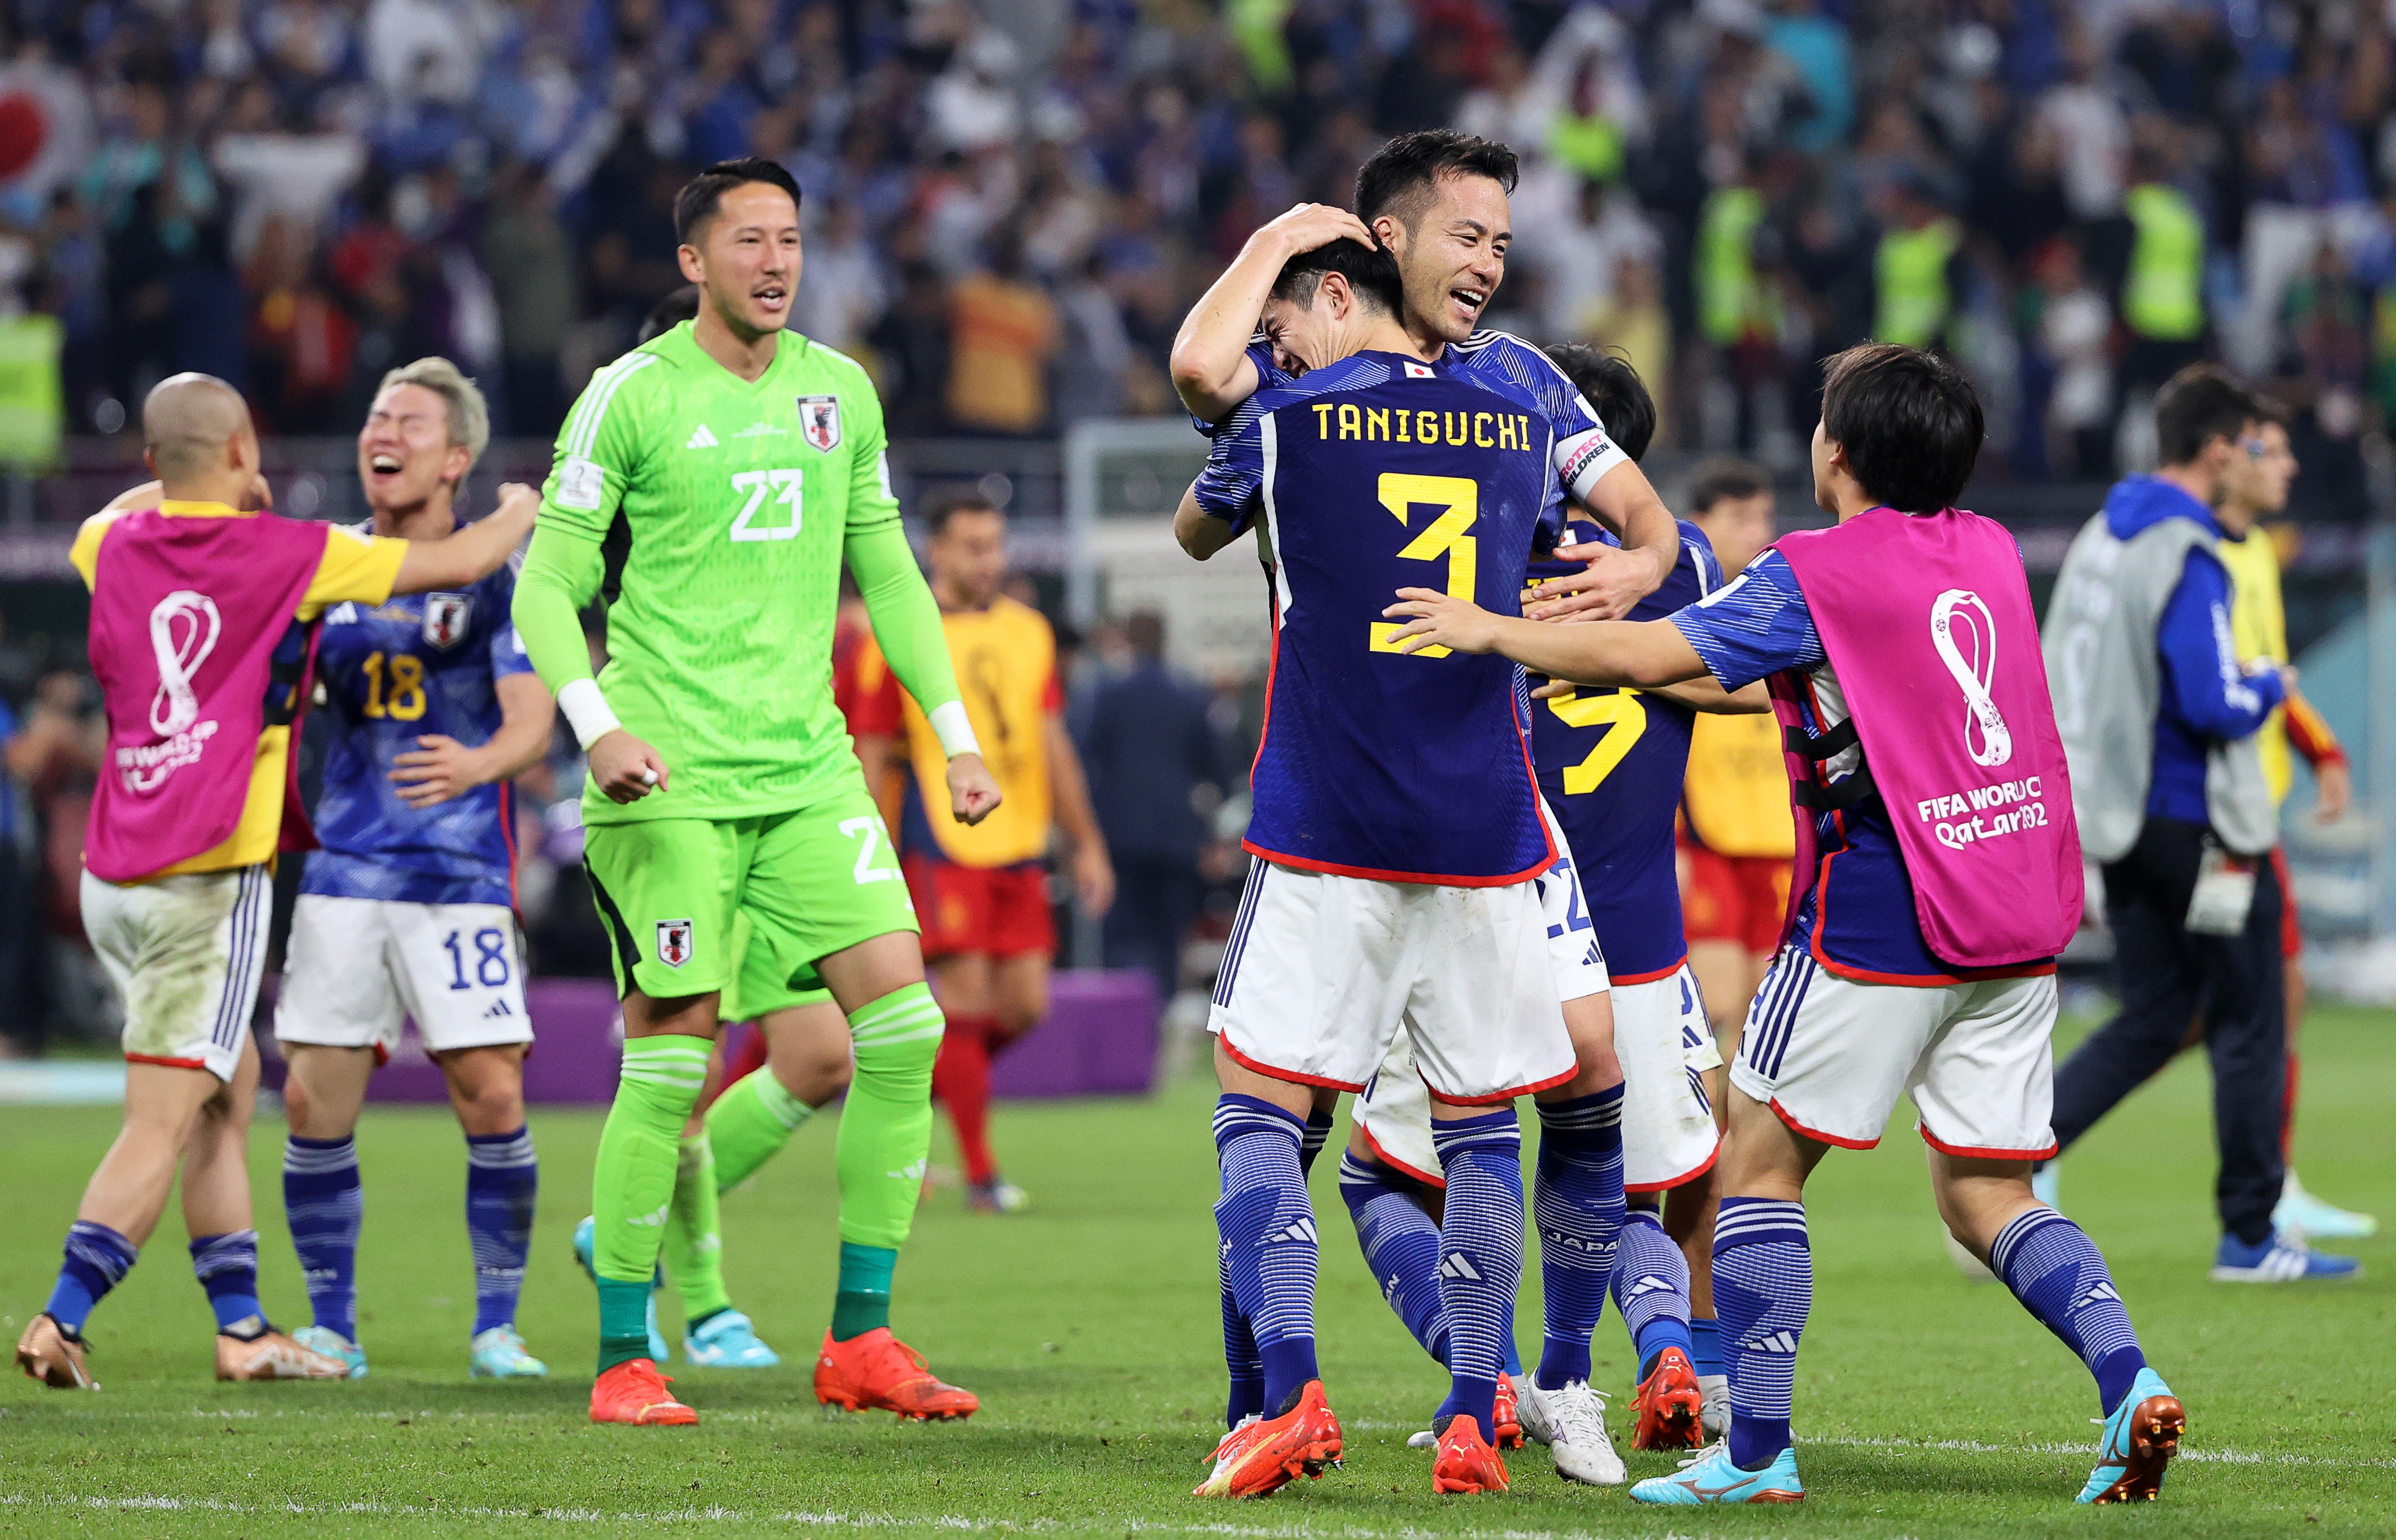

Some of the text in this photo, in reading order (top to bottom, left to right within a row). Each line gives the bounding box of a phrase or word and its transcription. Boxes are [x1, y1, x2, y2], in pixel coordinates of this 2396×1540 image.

[1312, 404, 1531, 452] TANIGUCHI
[1560, 433, 1602, 481] ROTECT
[1565, 442, 1611, 489] HILDREN
[730, 468, 803, 542] 23
[1370, 472, 1478, 658] 3
[363, 651, 427, 721] 18
[1917, 793, 1971, 823] FIFA
[1934, 810, 2021, 851] Qatar
[445, 929, 509, 990] 18
[1547, 1232, 1621, 1252] JAPA
